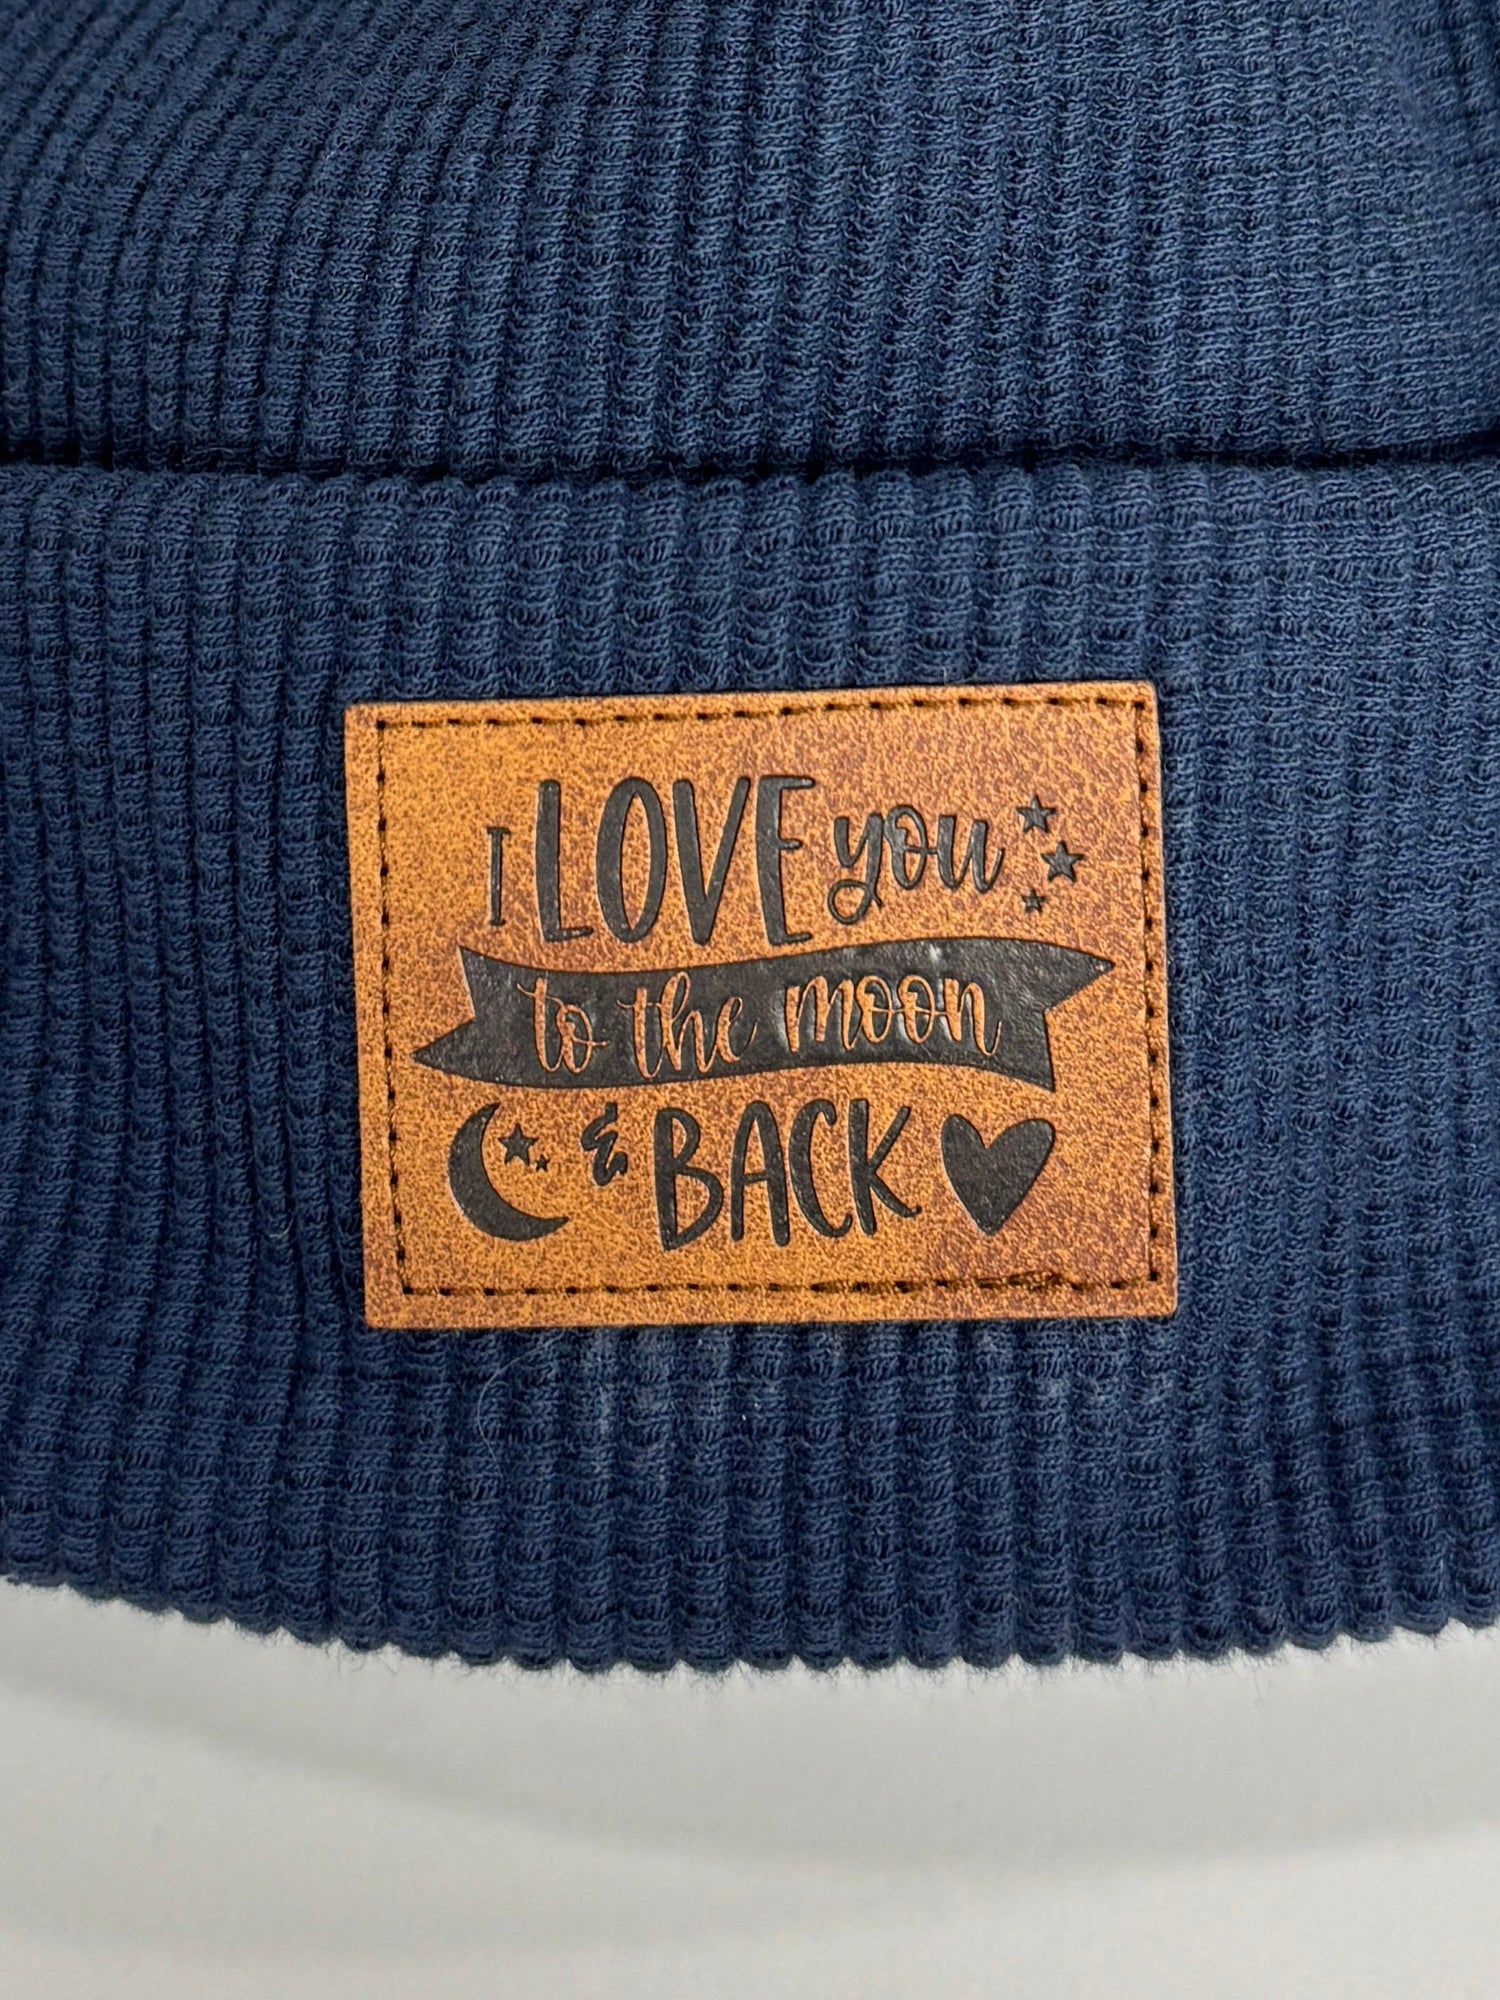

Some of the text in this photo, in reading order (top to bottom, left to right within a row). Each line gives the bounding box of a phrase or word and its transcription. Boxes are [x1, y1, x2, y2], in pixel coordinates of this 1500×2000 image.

[486, 775, 1005, 946] I LOVE you
[517, 971, 1001, 1079] to the moon
[580, 1098, 922, 1252] & BACK
